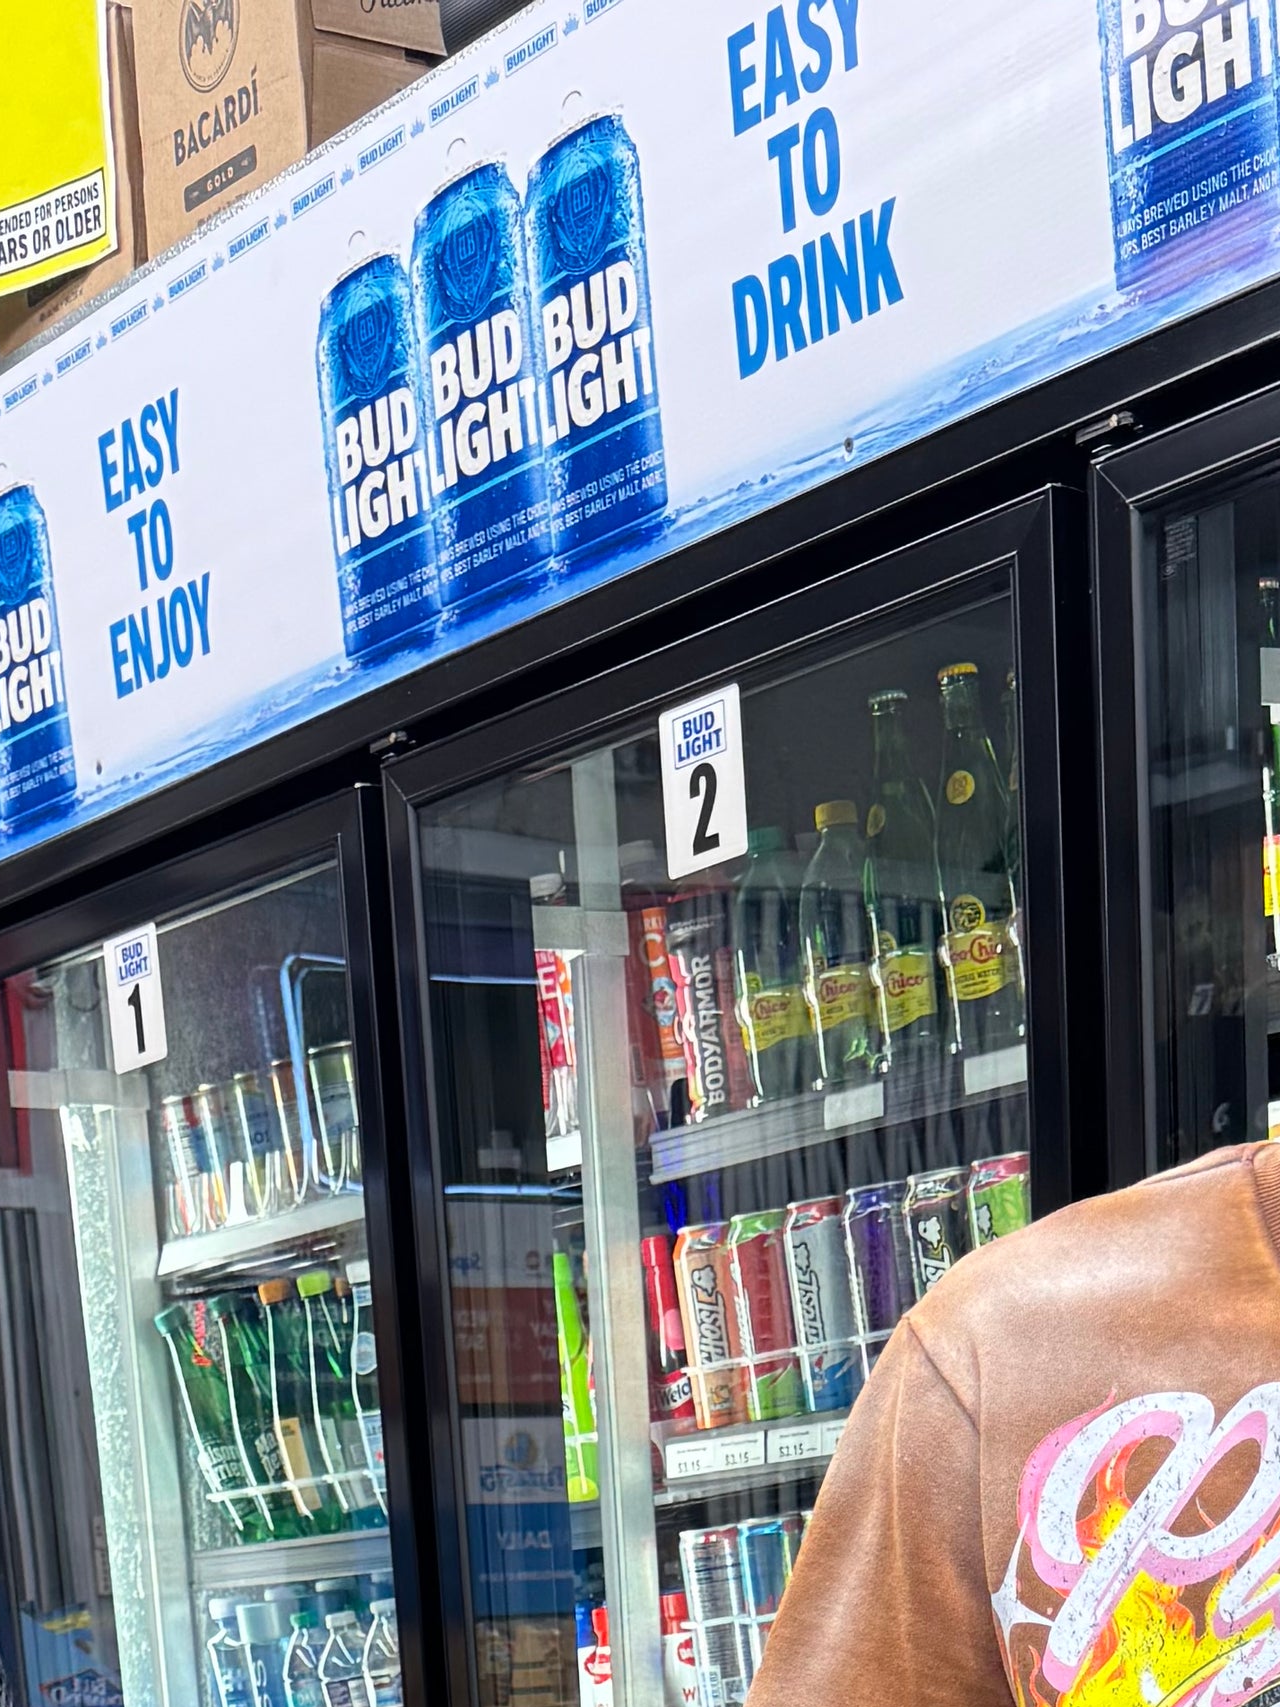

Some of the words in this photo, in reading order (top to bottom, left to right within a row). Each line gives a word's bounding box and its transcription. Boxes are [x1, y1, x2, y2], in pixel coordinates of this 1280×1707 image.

[506, 51, 526, 72] BUD
[526, 28, 556, 58] LIGHT
[727, 0, 859, 137] EASY
[1109, 0, 1273, 153] LIGHT
[173, 71, 263, 167] BACARDÍ
[33, 202, 53, 224] FOR
[54, 181, 100, 220] PERSONS
[205, 165, 235, 193] GOLD
[767, 107, 840, 234] TO
[1144, 186, 1189, 227] BREWED
[1192, 172, 1228, 200] USING
[32, 228, 51, 254] OR
[54, 204, 102, 246] OLDER
[1169, 205, 1215, 237] BARLEY
[542, 259, 639, 374] BUD
[731, 196, 904, 381] DRINK
[429, 306, 523, 423] BUD
[539, 325, 654, 446] LIGHT
[97, 386, 181, 513] EASY
[334, 386, 417, 488] BUD
[428, 374, 537, 498] LIGHT
[127, 497, 174, 592] TO
[336, 449, 432, 556] LIGHT
[108, 571, 211, 700] ENJOY
[677, 728, 723, 763] LIGHT
[681, 711, 715, 740] BUD
[688, 762, 720, 856] 2
[119, 956, 149, 981] LIGHT
[120, 941, 144, 963] BUD
[127, 983, 145, 1053] 1
[691, 953, 727, 1106] BODYARMOR
